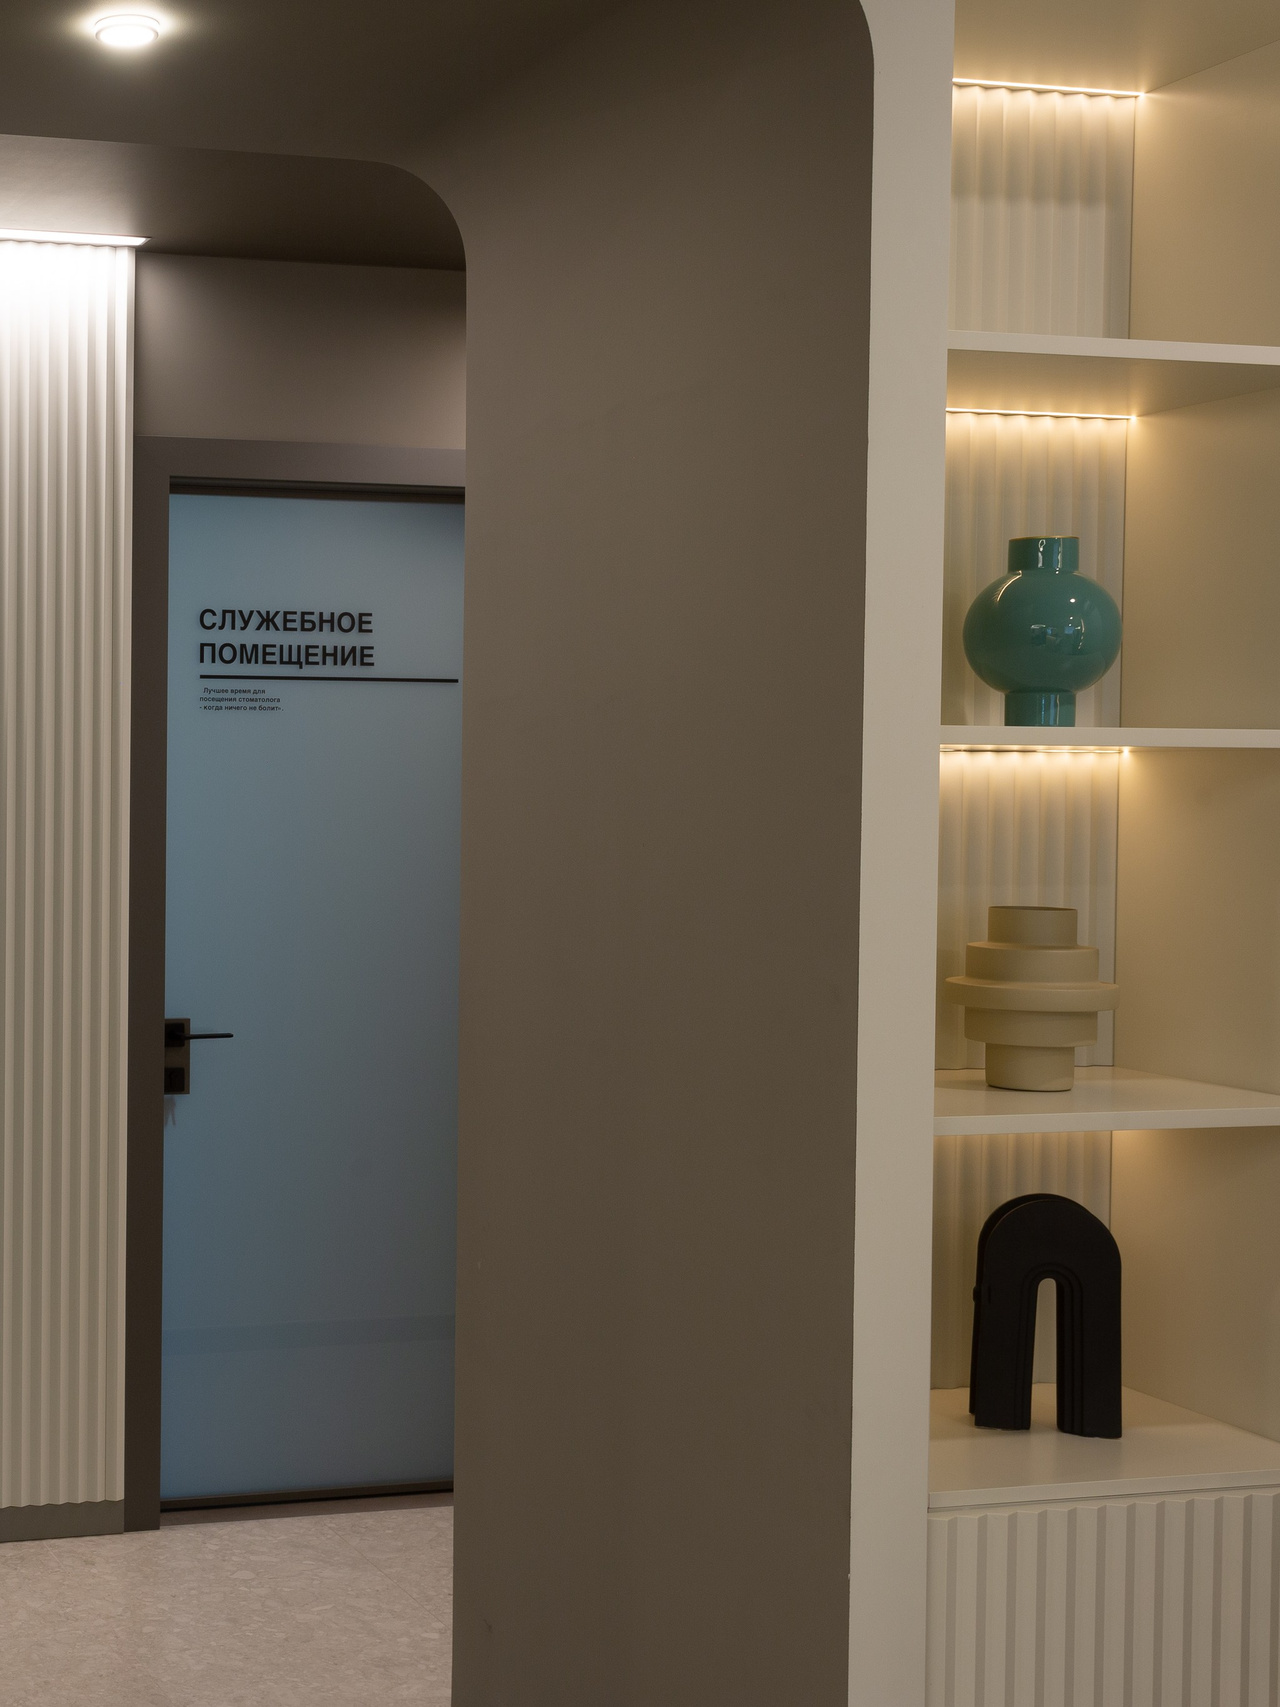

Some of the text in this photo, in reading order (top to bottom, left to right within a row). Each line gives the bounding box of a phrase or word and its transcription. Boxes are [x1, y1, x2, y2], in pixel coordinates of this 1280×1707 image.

[199, 608, 374, 634] СЛУЖЕБНОЕ
[199, 642, 376, 670] ПОМЕЩЕНИЕ
[203, 687, 229, 695] Лучшее
